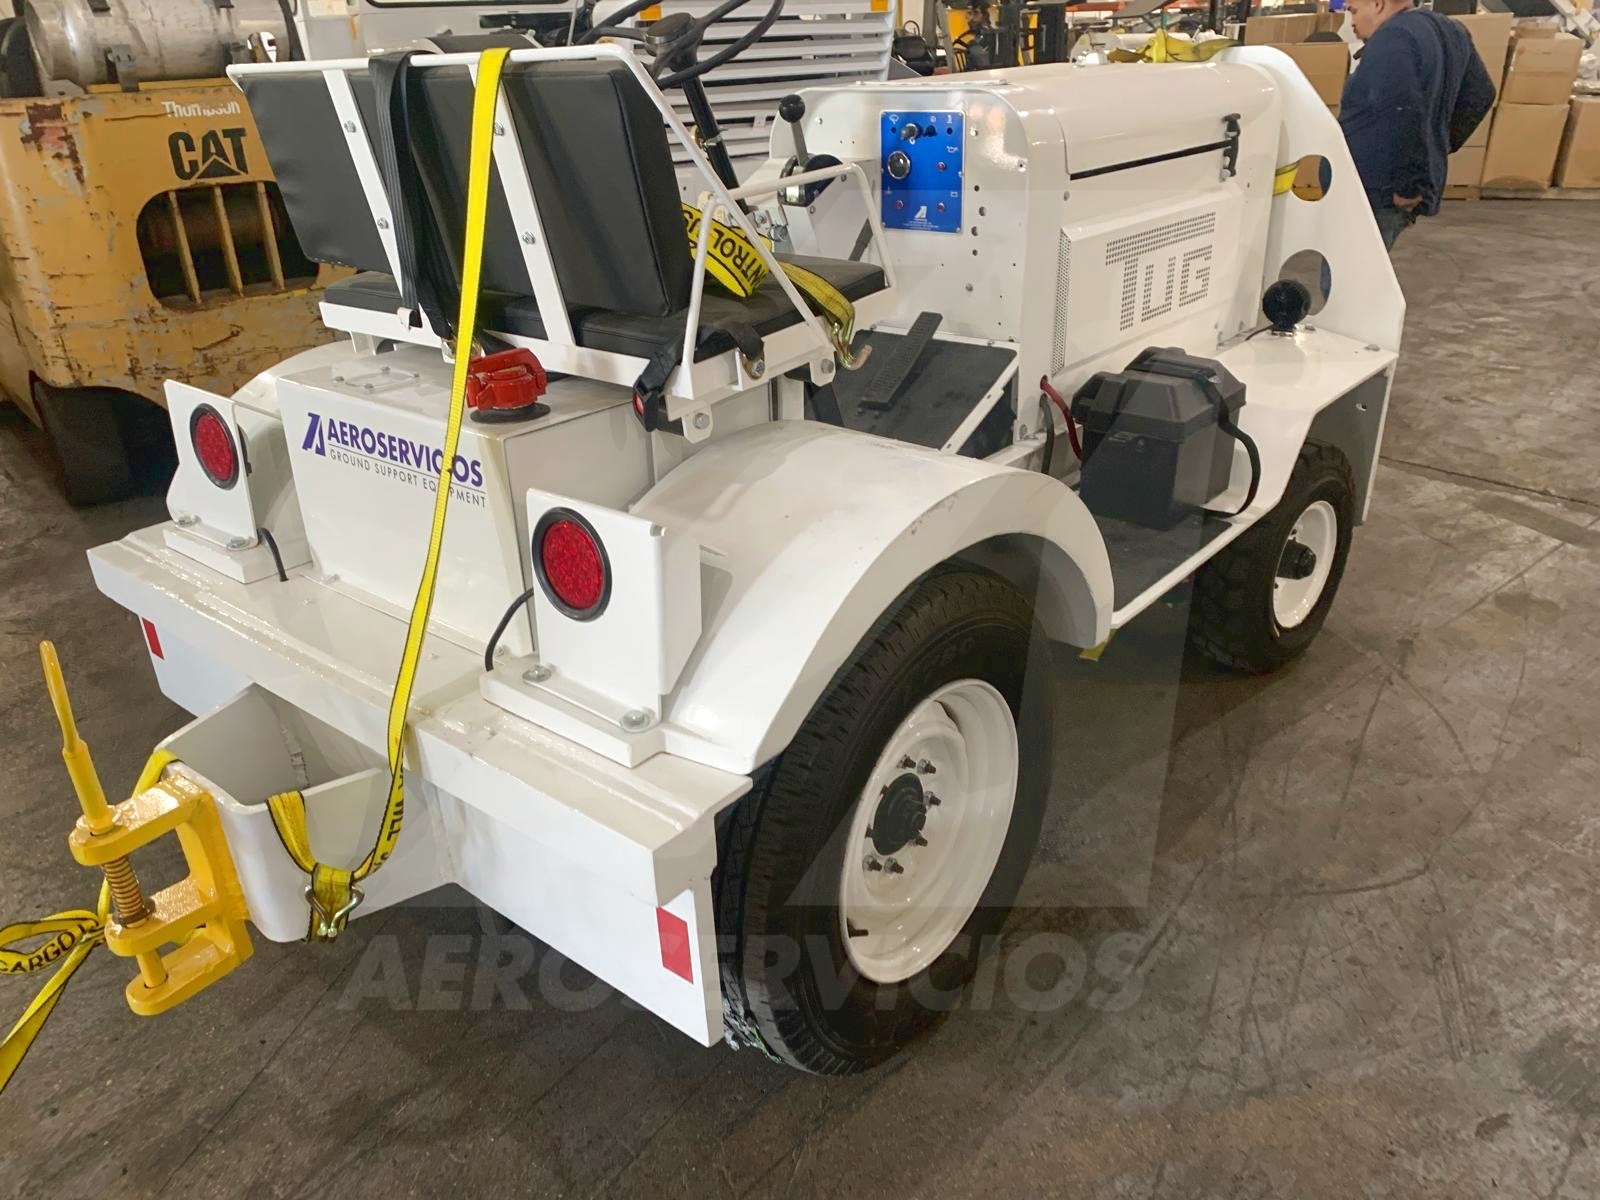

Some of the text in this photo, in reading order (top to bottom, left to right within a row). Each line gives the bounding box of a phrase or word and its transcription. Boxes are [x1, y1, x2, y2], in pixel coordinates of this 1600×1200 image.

[168, 127, 248, 180] CAT
[1105, 212, 1216, 331] TUG
[327, 418, 483, 487] AEROSERVICOS
[330, 449, 487, 508] GROUND SUPPORT EQPMENT
